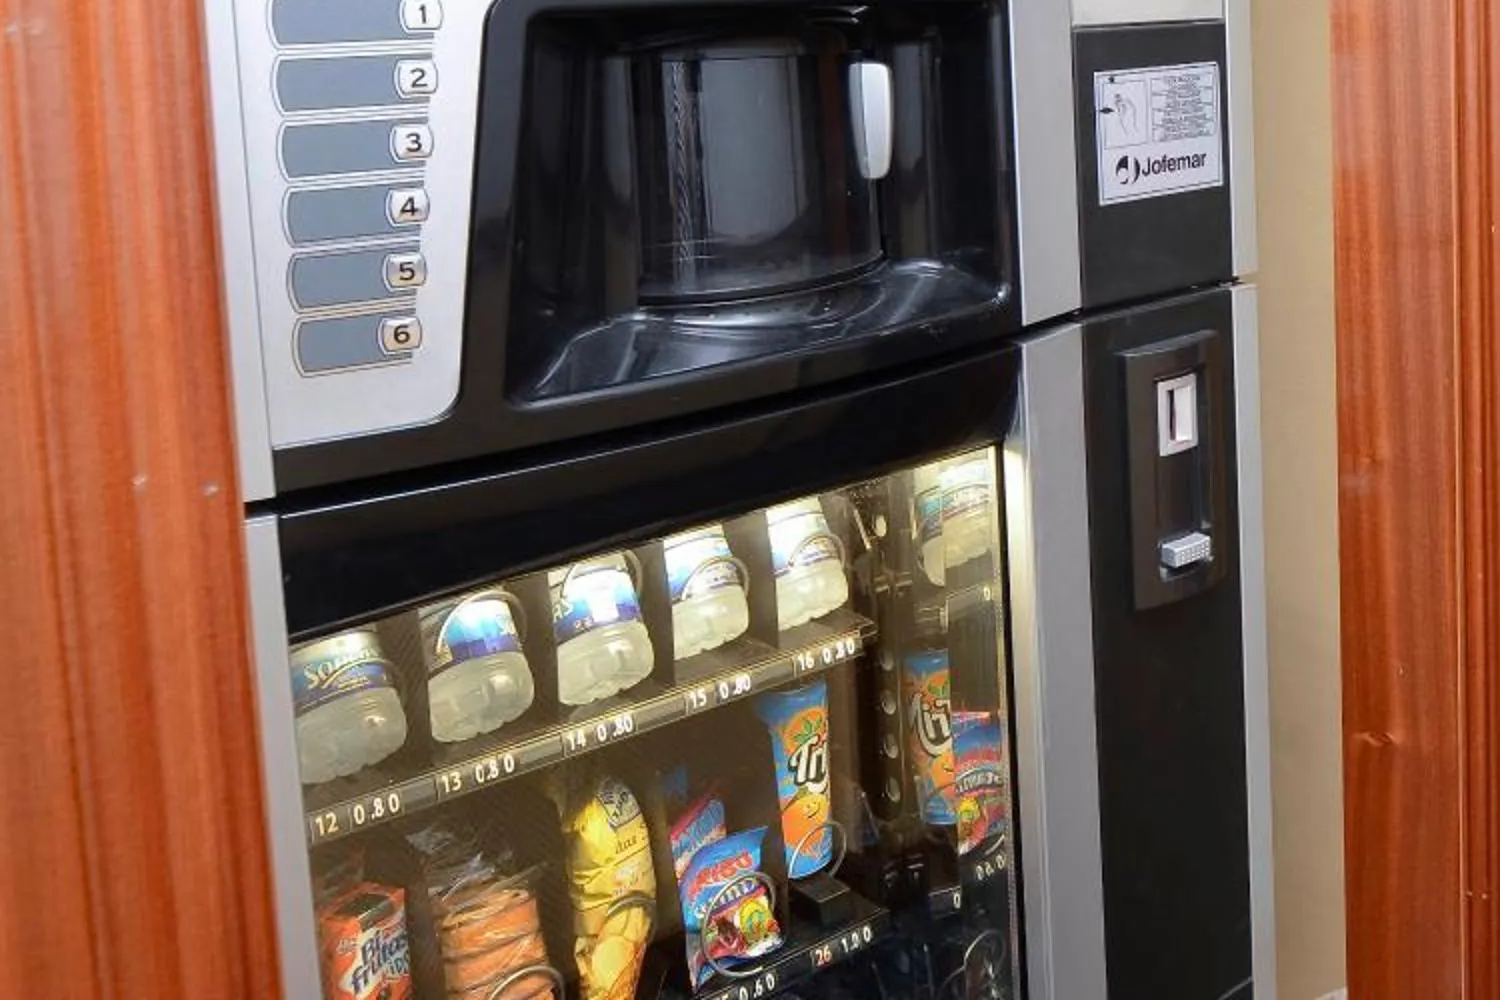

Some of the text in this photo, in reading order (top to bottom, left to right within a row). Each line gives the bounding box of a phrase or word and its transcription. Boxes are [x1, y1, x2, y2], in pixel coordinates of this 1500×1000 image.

[418, 3, 427, 25] 1
[410, 67, 428, 88] 2
[405, 132, 422, 152] 3
[1142, 153, 1207, 177] Jofemar
[400, 196, 418, 216] 4
[399, 260, 415, 281] 5
[393, 324, 411, 345] 6
[798, 651, 815, 671] 16
[689, 689, 707, 709] 15
[567, 730, 587, 751] 14
[441, 771, 463, 794] 13
[315, 811, 340, 837] 12
